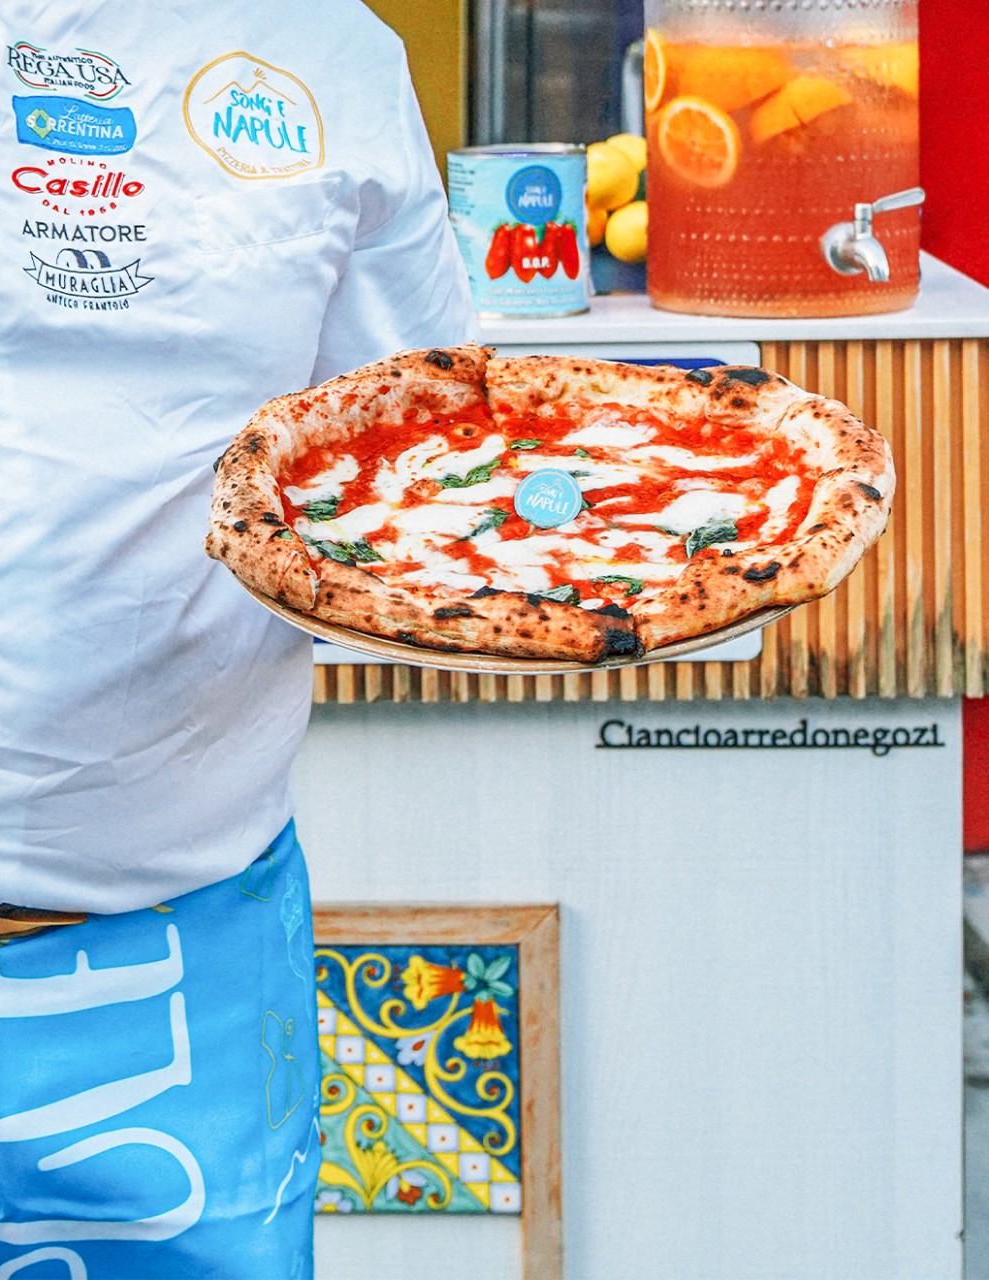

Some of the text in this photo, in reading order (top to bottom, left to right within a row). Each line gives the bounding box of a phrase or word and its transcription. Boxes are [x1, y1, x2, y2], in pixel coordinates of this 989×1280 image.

[5, 45, 132, 86] REGA USA
[73, 80, 96, 91] FOOD
[213, 106, 310, 153] NAPULE
[217, 146, 257, 174] PIZZERIA
[11, 166, 146, 198] Casillo
[22, 219, 147, 242] ARMATORE
[45, 271, 129, 293] MURAGLIA
[46, 294, 79, 309] ANTICO
[525, 493, 570, 515] NAPULE
